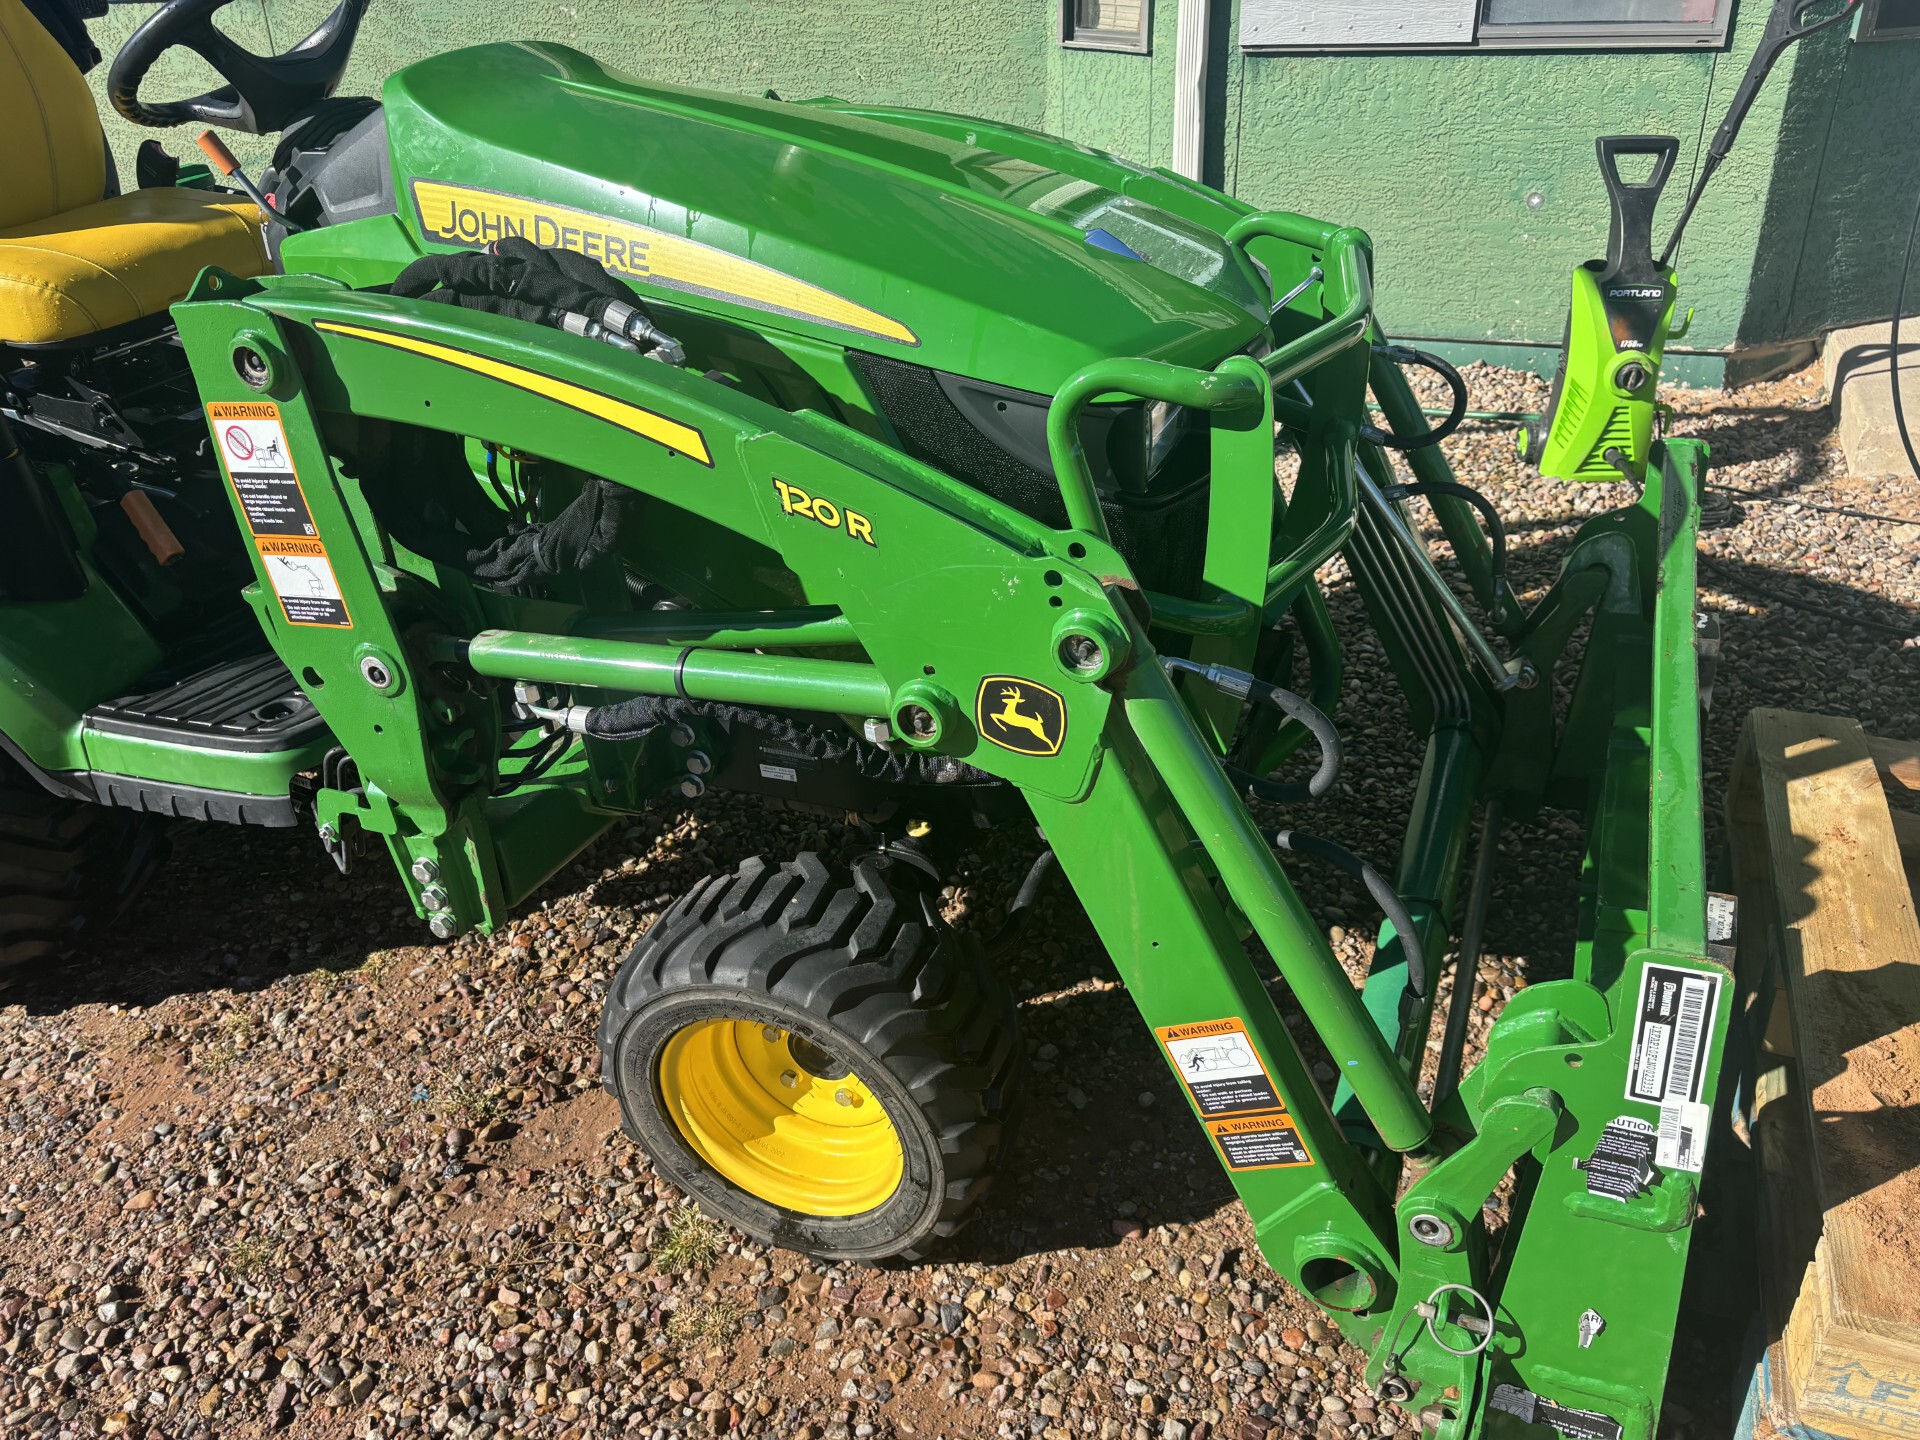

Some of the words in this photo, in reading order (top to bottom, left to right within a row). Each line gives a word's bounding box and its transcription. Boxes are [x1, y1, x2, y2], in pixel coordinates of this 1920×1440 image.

[441, 200, 525, 240] JOHN
[534, 215, 650, 272] DEERE
[1609, 289, 1661, 297] PORTLAND
[221, 406, 275, 417] WARNING
[269, 542, 322, 554] WARNING
[1660, 982, 1676, 1016] FRONTIER
[1179, 1022, 1234, 1036] WARNING
[1231, 1119, 1284, 1131] WARNING
